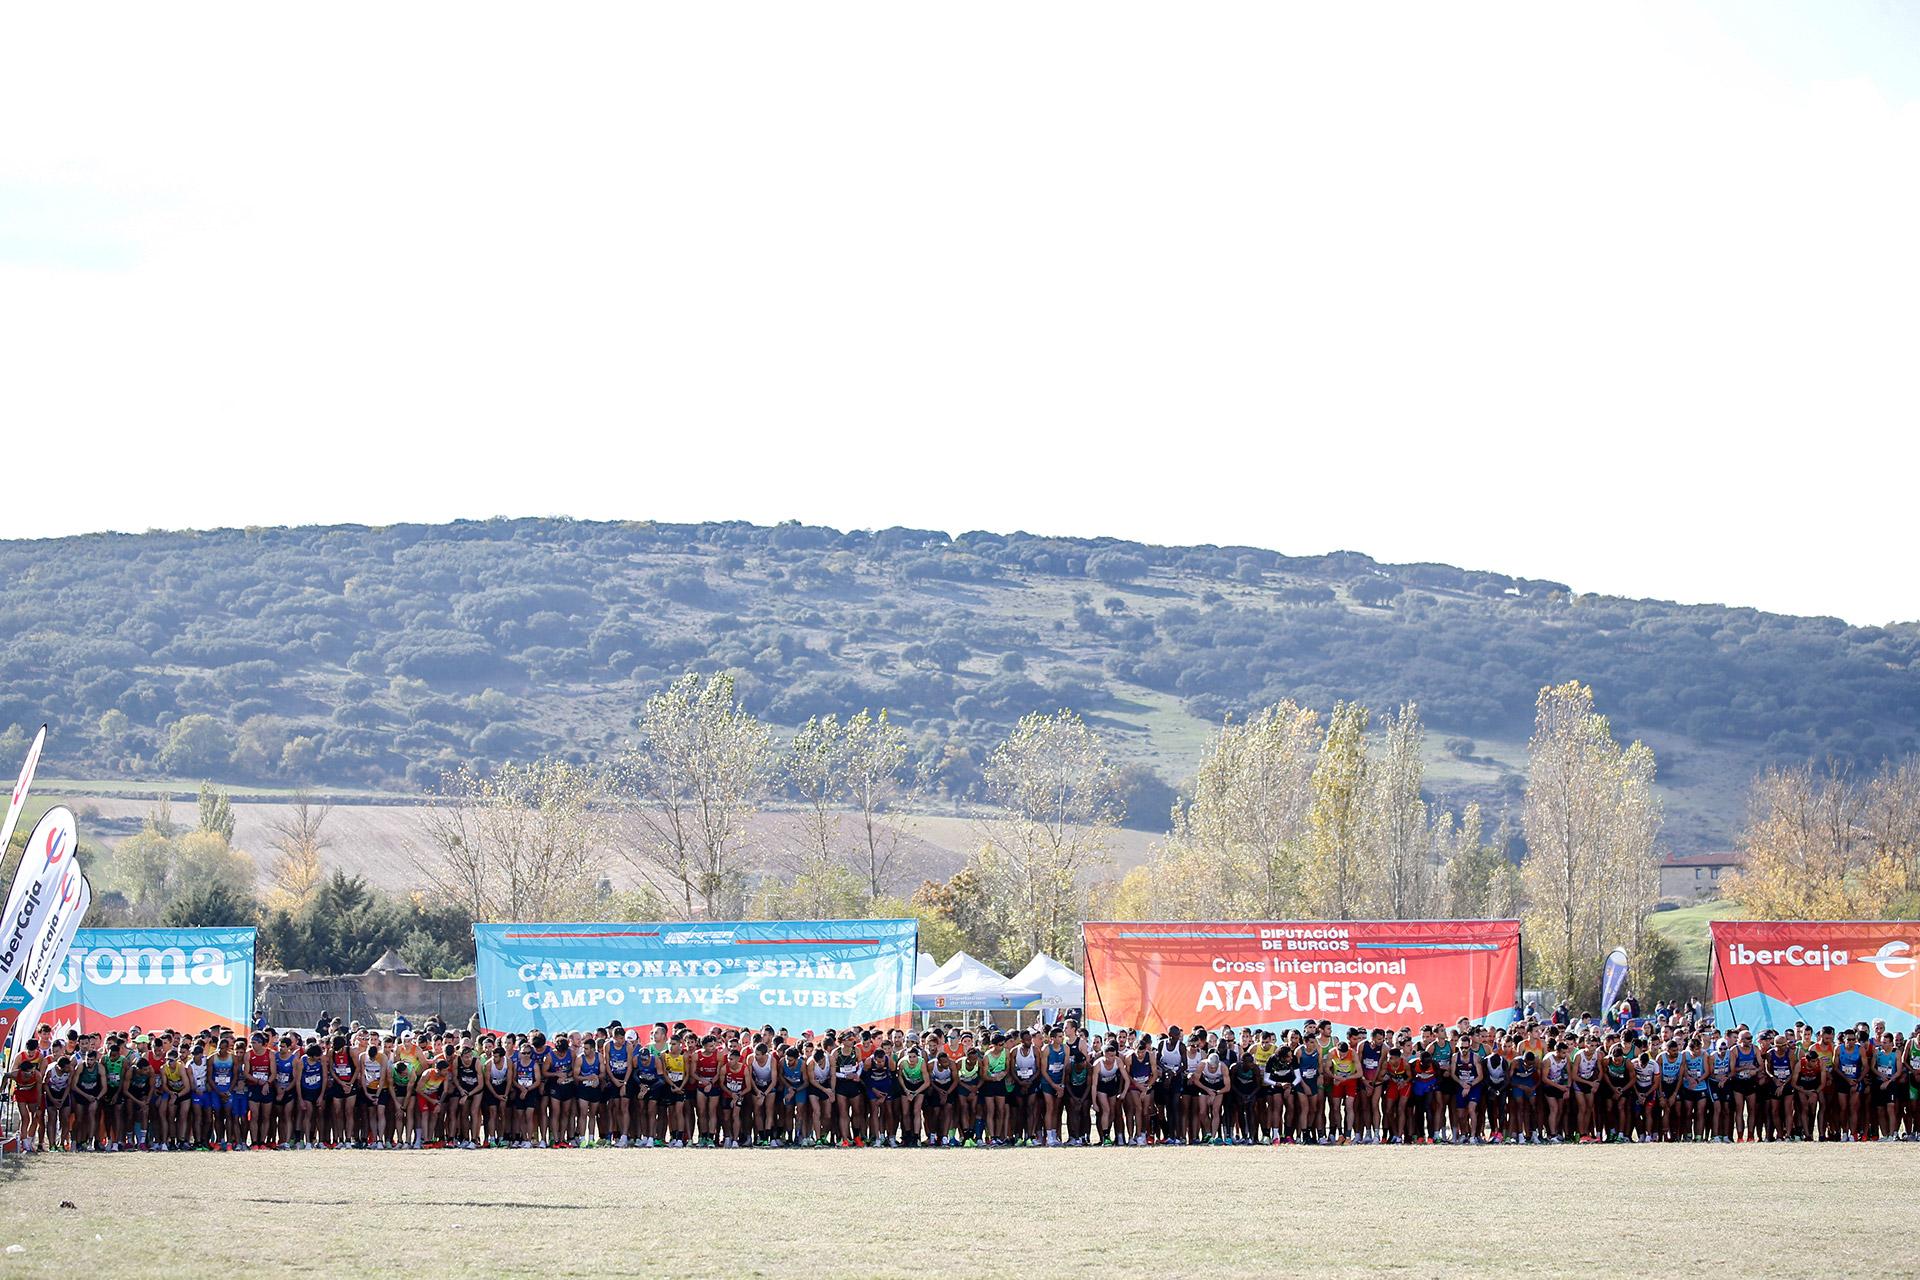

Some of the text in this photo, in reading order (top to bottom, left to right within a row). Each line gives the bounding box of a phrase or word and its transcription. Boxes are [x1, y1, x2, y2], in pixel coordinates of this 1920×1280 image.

[1260, 927, 1349, 939] DIPUTACIÓN
[1262, 940, 1350, 950] DE BURGOS
[518, 956, 856, 981] CAMPEONATO DE ESPAÑA
[1212, 957, 1406, 975] Cross Internacional
[1729, 943, 1848, 971] iberCaja
[507, 989, 521, 998] DE
[522, 988, 625, 1010] CAMPO
[639, 984, 739, 1004] TRAVÉS
[759, 987, 858, 1009] CLUBES
[1195, 980, 1424, 1014] ATAPUERCA
